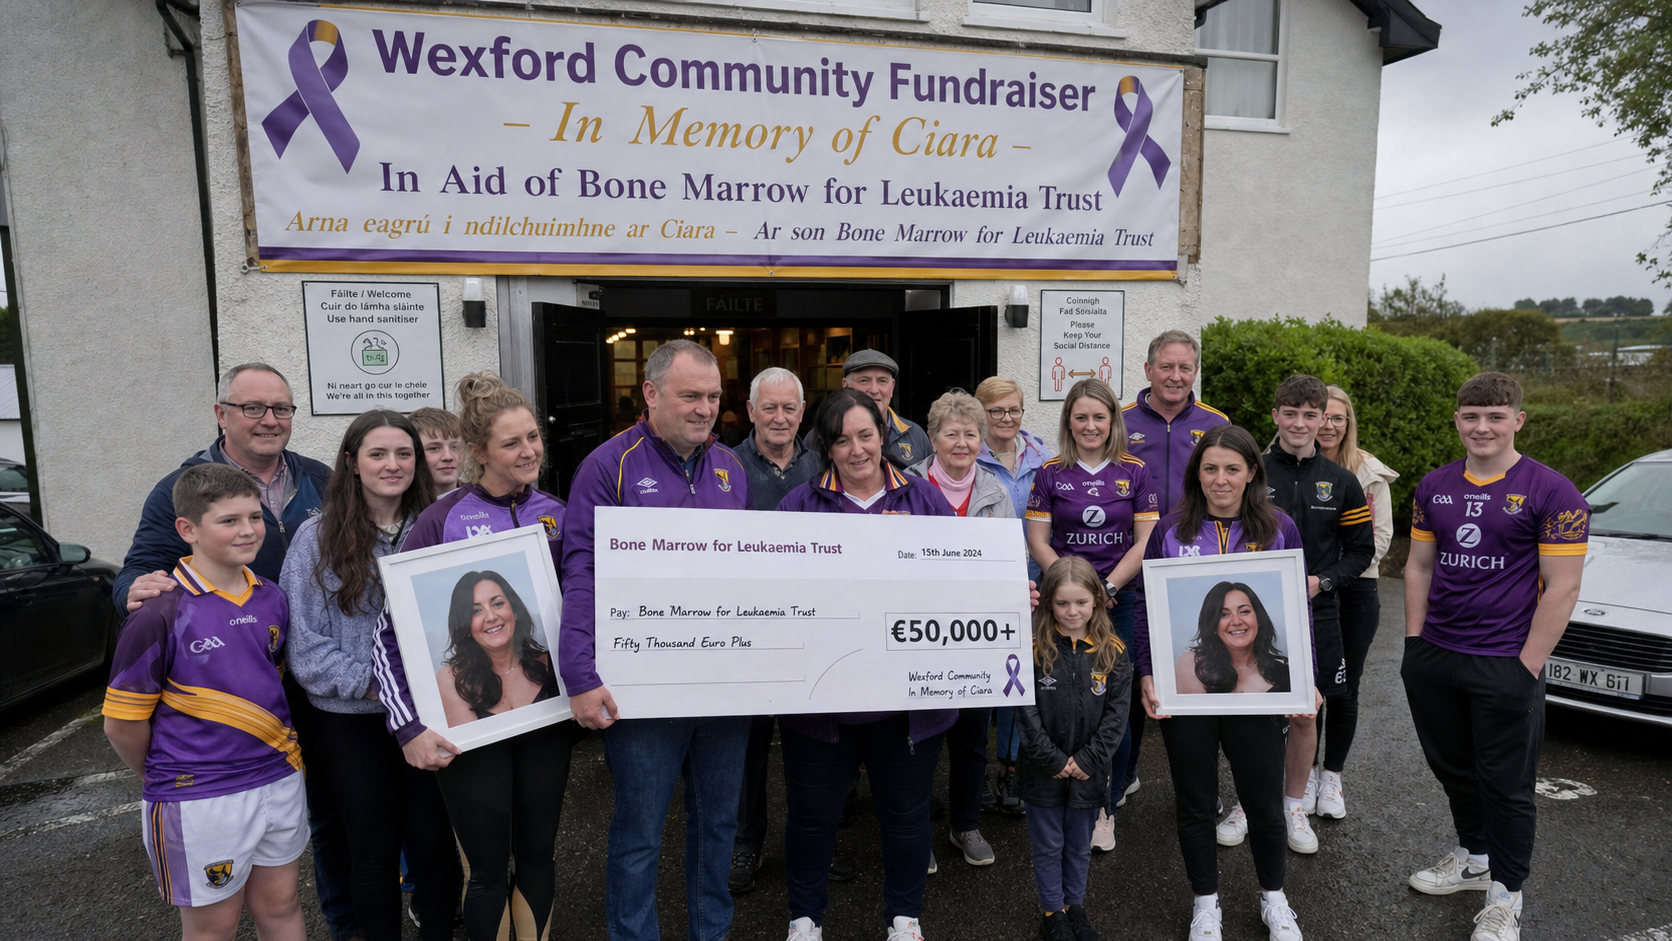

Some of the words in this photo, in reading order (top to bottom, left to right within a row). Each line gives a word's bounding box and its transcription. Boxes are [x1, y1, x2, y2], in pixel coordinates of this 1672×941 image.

[372, 29, 595, 83] Wexford
[615, 44, 874, 108] Community
[890, 62, 1096, 111] Fundraiser
[550, 102, 602, 143] In
[628, 105, 813, 163] Memory
[832, 115, 881, 165] of
[892, 117, 998, 158] Ciara
[379, 162, 421, 192] In
[439, 165, 507, 195] Aid
[525, 168, 562, 196] of
[577, 169, 666, 200] Bone
[682, 173, 809, 203] Marrow
[824, 177, 867, 204] for
[881, 180, 1028, 209] Leukaemia
[1039, 185, 1102, 211] Trust
[285, 211, 348, 232] Arna
[364, 214, 430, 239] eagrú
[444, 215, 452, 234] i
[464, 216, 615, 237] ndilchuimhne
[627, 224, 649, 237] ar
[661, 219, 715, 239] Ciara
[753, 221, 781, 239] Ar
[791, 227, 825, 240] son
[836, 222, 885, 241] Bone
[894, 224, 968, 243] Marrow
[976, 225, 1003, 243] for
[1012, 226, 1104, 245] Leukaemia
[1115, 229, 1154, 246] Trust
[331, 289, 358, 298] Fáilte
[367, 290, 412, 298] Welcome
[320, 302, 341, 311] Cuir
[344, 302, 358, 311] do
[360, 302, 390, 311] lámha
[393, 302, 425, 311] sláinte
[706, 294, 763, 311] FÁILTE
[1066, 296, 1100, 306] Coinnigh
[327, 314, 346, 323] Use
[349, 314, 374, 323] hand
[377, 315, 419, 323] sanitiser
[1070, 321, 1095, 329] Please
[1063, 331, 1083, 340] Keep
[1084, 331, 1102, 339] Your
[1053, 342, 1077, 350] Social
[1078, 342, 1111, 350] Distance
[364, 383, 376, 391] go
[395, 391, 430, 400] together
[1465, 501, 1484, 517] 13
[1066, 532, 1123, 545] ZURICH
[610, 538, 646, 550] Bone
[652, 539, 707, 551] Marrow
[712, 539, 733, 552] for
[738, 541, 806, 553] Leukaemia
[810, 542, 842, 554] Trust
[898, 550, 917, 559] Date:
[921, 548, 940, 557] 15th
[941, 549, 960, 557] June
[963, 549, 982, 557] 2024
[1440, 552, 1505, 570] ZURICH
[610, 608, 630, 620] Pay:
[638, 606, 665, 617] Bone
[670, 605, 711, 617] Marrow
[716, 606, 731, 617] for
[736, 606, 786, 617] Leukaemia
[790, 606, 816, 617] Trust
[891, 619, 1016, 646] €50,000+
[613, 637, 640, 653] Fifty
[646, 637, 696, 648] Thousand
[701, 637, 726, 648] Euro
[731, 636, 752, 648] Plus
[908, 671, 943, 681] Wexford
[947, 670, 991, 683] Community
[908, 687, 916, 697] In
[920, 687, 954, 700] Memory
[958, 686, 967, 697] of
[970, 685, 993, 695] Ciara
